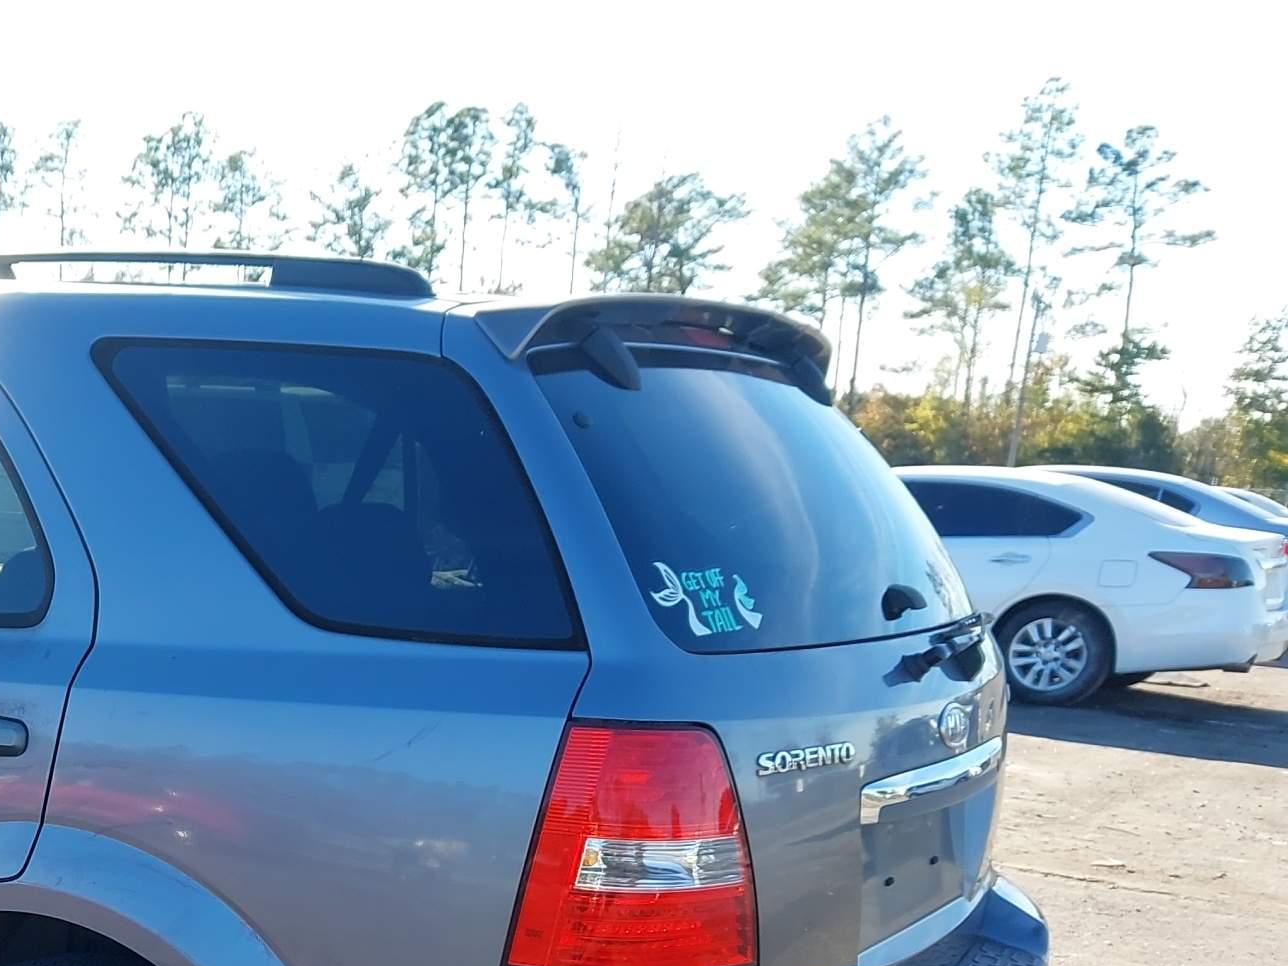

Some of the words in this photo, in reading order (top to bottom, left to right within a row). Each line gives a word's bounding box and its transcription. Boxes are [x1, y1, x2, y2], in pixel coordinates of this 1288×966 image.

[681, 572, 704, 591] GET
[705, 568, 724, 588] OFF
[699, 590, 721, 609] MY
[701, 607, 743, 633] TAIL
[756, 742, 855, 776] SORENTO
